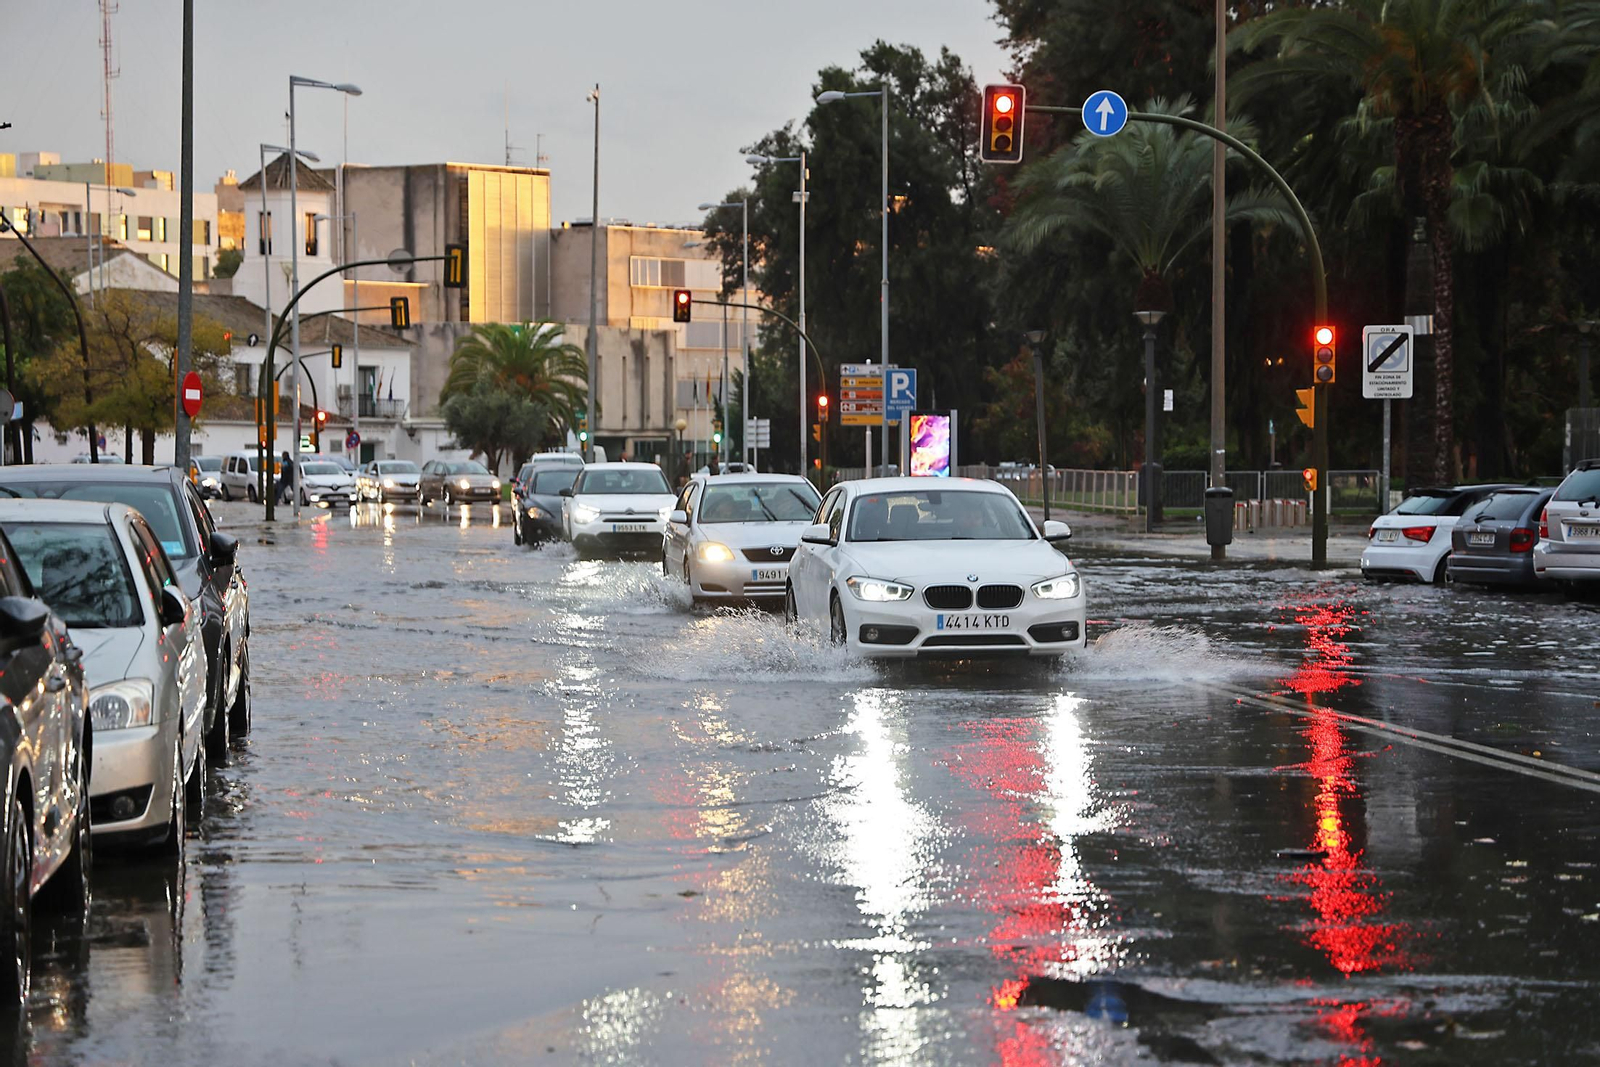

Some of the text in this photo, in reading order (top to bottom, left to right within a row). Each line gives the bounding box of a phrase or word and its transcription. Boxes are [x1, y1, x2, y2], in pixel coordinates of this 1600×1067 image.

[891, 372, 910, 399] P
[758, 570, 782, 579] 9491
[945, 615, 1010, 628] 4414 KTD
